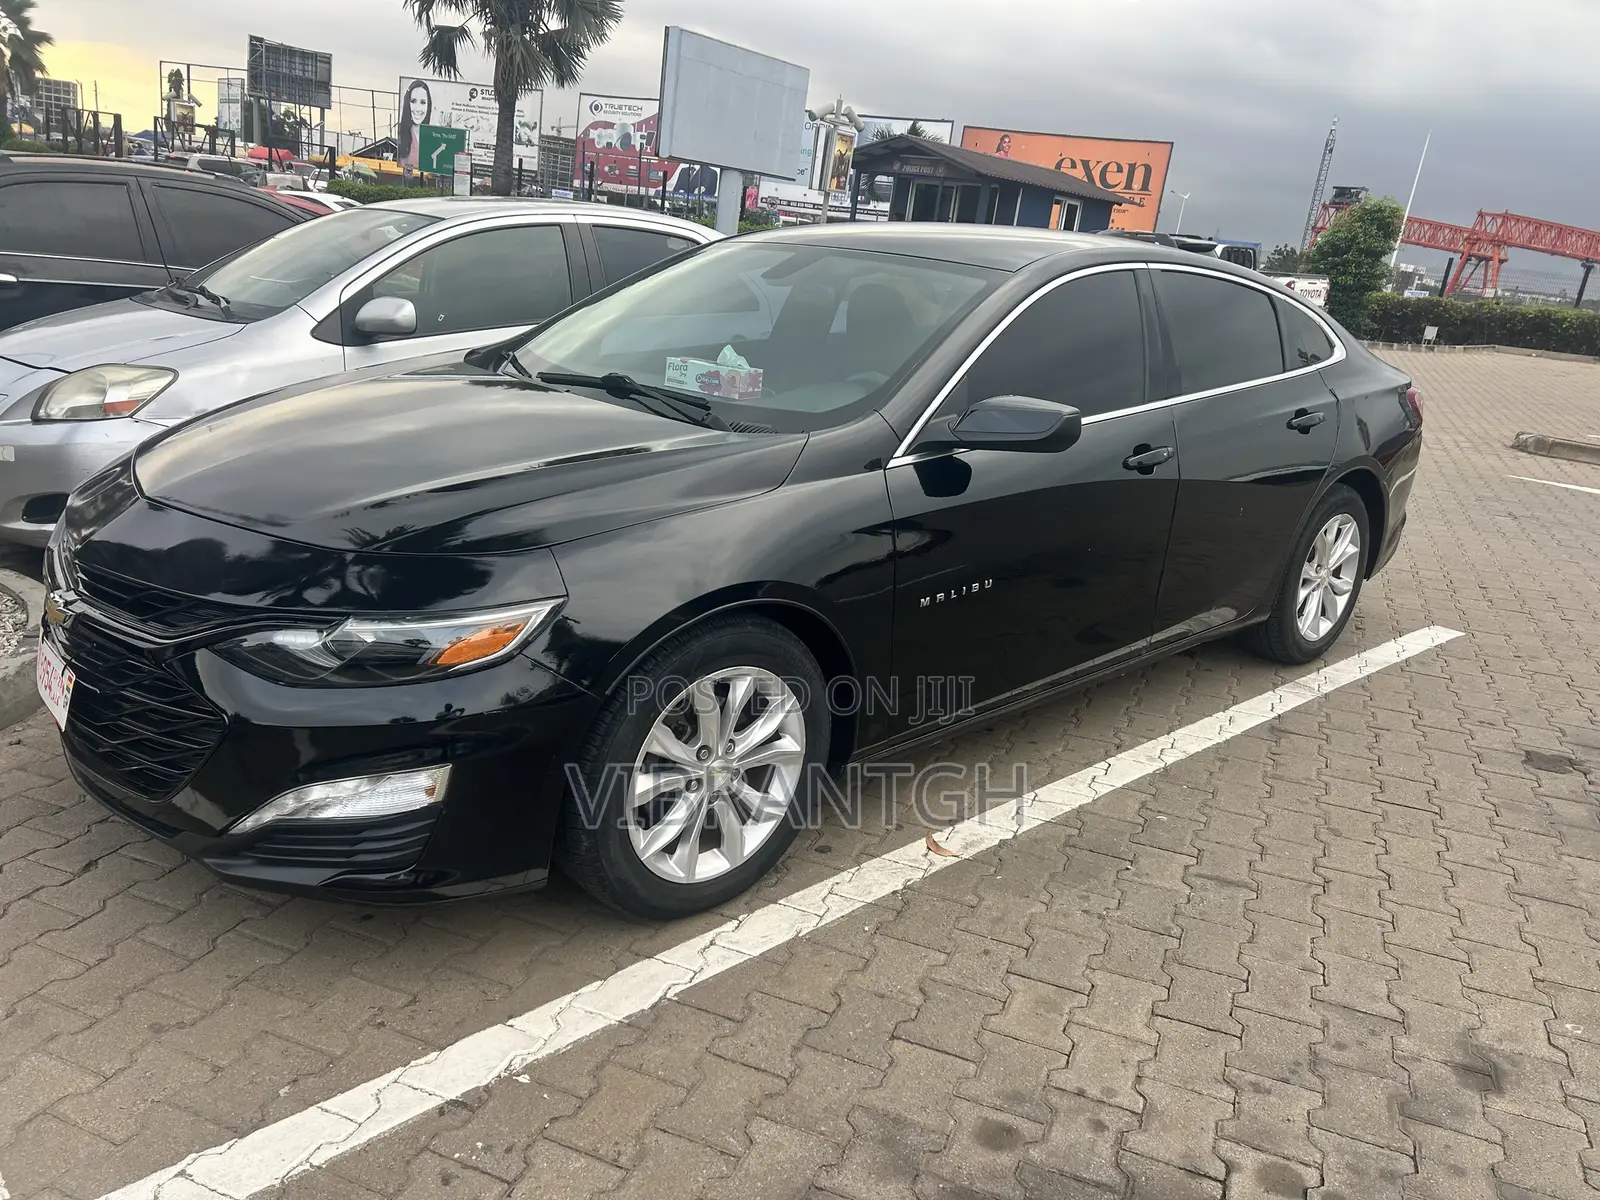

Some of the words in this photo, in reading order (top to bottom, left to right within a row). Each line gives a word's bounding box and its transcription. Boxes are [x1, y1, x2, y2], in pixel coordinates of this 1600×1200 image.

[603, 103, 643, 112] TRUETECH
[1299, 289, 1322, 299] TOYOTA
[667, 362, 688, 372] Flora
[919, 578, 993, 608] MALIBU
